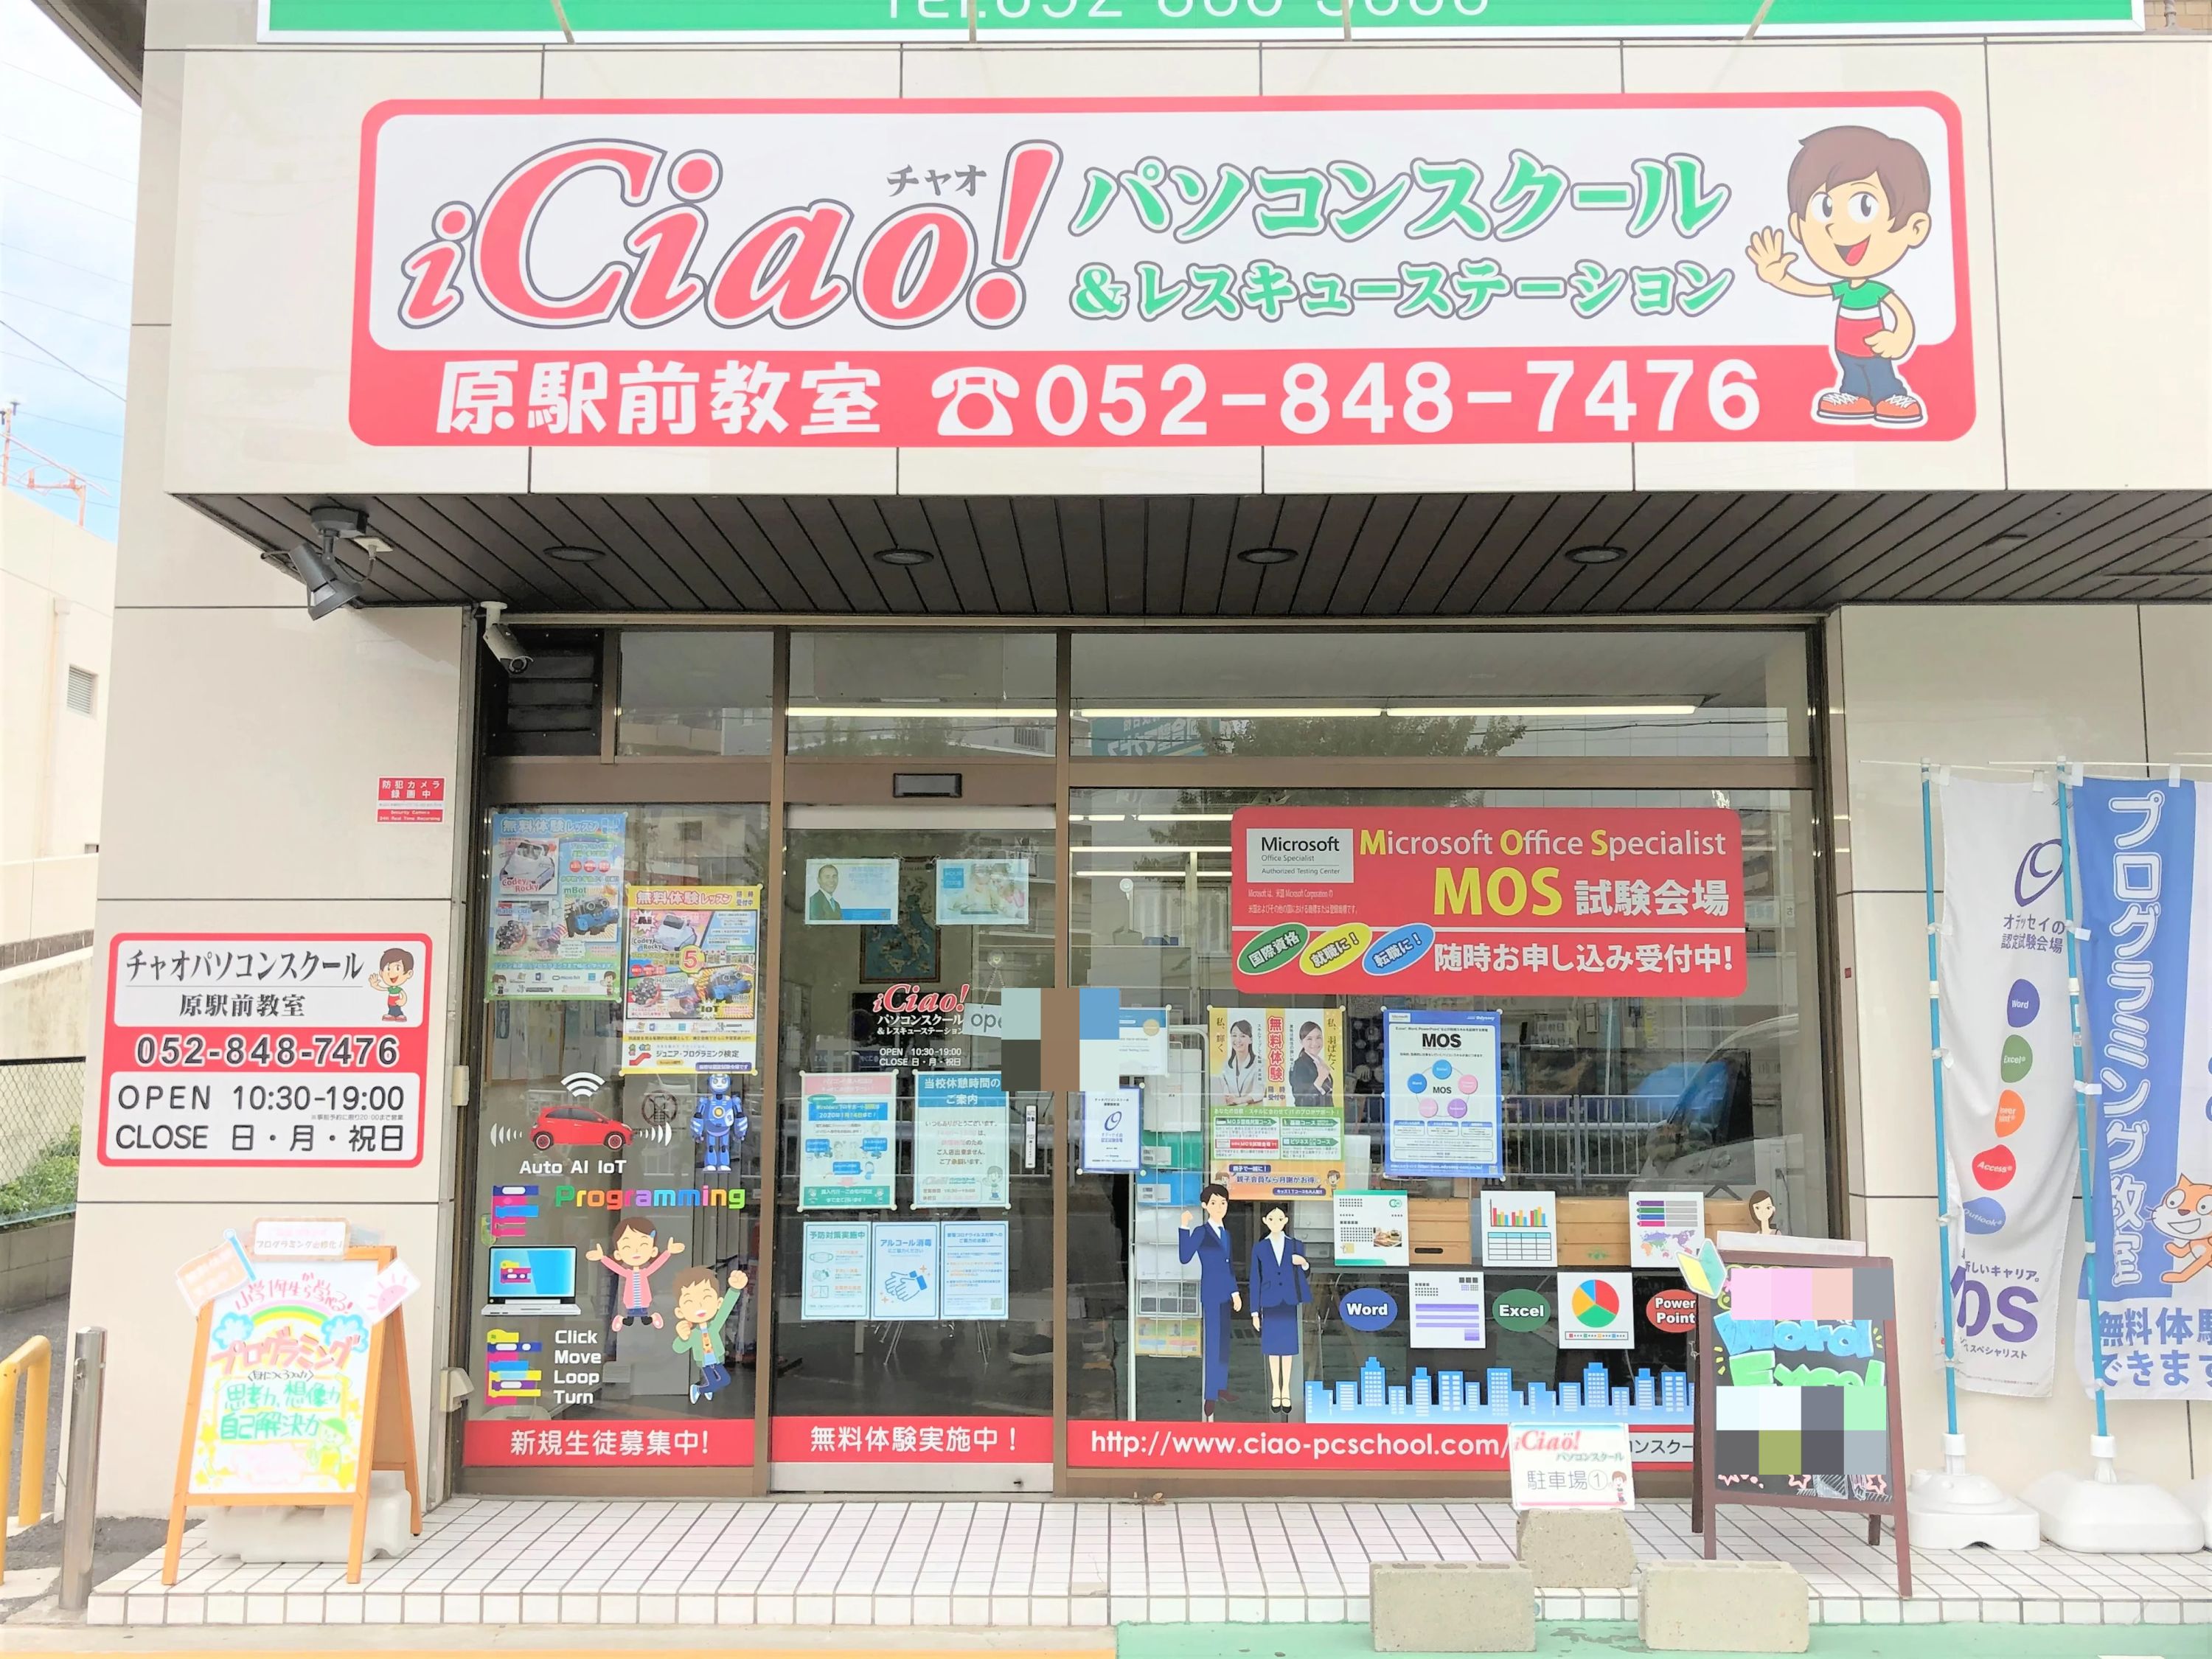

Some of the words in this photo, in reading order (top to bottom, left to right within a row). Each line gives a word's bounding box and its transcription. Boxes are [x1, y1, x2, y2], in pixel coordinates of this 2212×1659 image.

[886, 164, 987, 198] チャオ
[1068, 150, 1731, 245] パソコンスクール
[398, 138, 1063, 329] iCiao!
[1068, 258, 1736, 322] &レスキューステーション
[437, 359, 881, 437] 原駅前教室
[1034, 358, 1761, 437] 052-848-7476
[382, 780, 440, 789] 防犯カメラ
[501, 818, 599, 834] 無料体験レッスン
[1262, 836, 1340, 852] Microsoft
[1360, 829, 1493, 856] Microsoft
[1500, 829, 1583, 857] Office
[1591, 829, 1726, 861] Specialist
[1283, 855, 1315, 863] Specialist
[636, 891, 732, 905] 無料体験レッスン
[1434, 866, 1563, 917] MOS
[1574, 879, 1730, 917] 試験会場
[1246, 930, 1301, 968] 国際資格
[2000, 933, 2064, 954] 認定試験会場
[126, 950, 364, 982] チャオパソコンスクール
[684, 950, 698, 969] 5
[1434, 944, 1733, 974] 随時お申し込み受付中!
[179, 994, 305, 1018] 原駅前教室
[872, 984, 970, 1012] iCiao!
[2011, 999, 2029, 1009] Word
[877, 1015, 964, 1026] パソコンスクール
[1267, 1015, 1285, 1082] 無料体験
[1422, 1033, 1462, 1048] MOS
[136, 1034, 399, 1068] 052-848-7476
[880, 1048, 903, 1056] OPEN
[911, 1048, 962, 1056] 10:30-19:00
[879, 1058, 908, 1066] CLOSE
[925, 1077, 1001, 1089] 当校休憩時間の
[1433, 1086, 1452, 1094] MOS
[118, 1085, 212, 1110] OPEN
[233, 1085, 405, 1110] 10:30-19:00
[946, 1094, 978, 1105] ご案内
[116, 1125, 209, 1150] CLOSE
[519, 1160, 563, 1174] Auto
[571, 1160, 588, 1174] AI
[598, 1160, 627, 1174] IoT
[554, 1184, 745, 1210] Programming
[1346, 1303, 1388, 1316] Word
[1498, 1304, 1545, 1318] Excel
[1655, 1298, 1696, 1310] Power
[1655, 1312, 1696, 1325] Point
[554, 1329, 598, 1344] Click
[211, 1326, 361, 1375] プログラミング
[554, 1350, 602, 1364] Move
[554, 1370, 600, 1385] Loop
[553, 1391, 594, 1405] Turn
[510, 1430, 709, 1455] 新規生徒募集中!
[810, 1426, 1016, 1453] 無料体験実施中!
[1091, 1430, 1509, 1458] http://www.ciao-pcschool.com/
[1514, 1430, 1582, 1452] iCiao!
[1630, 1439, 1693, 1454] ンスクー
[1556, 1452, 1624, 1462] パソコンスクール
